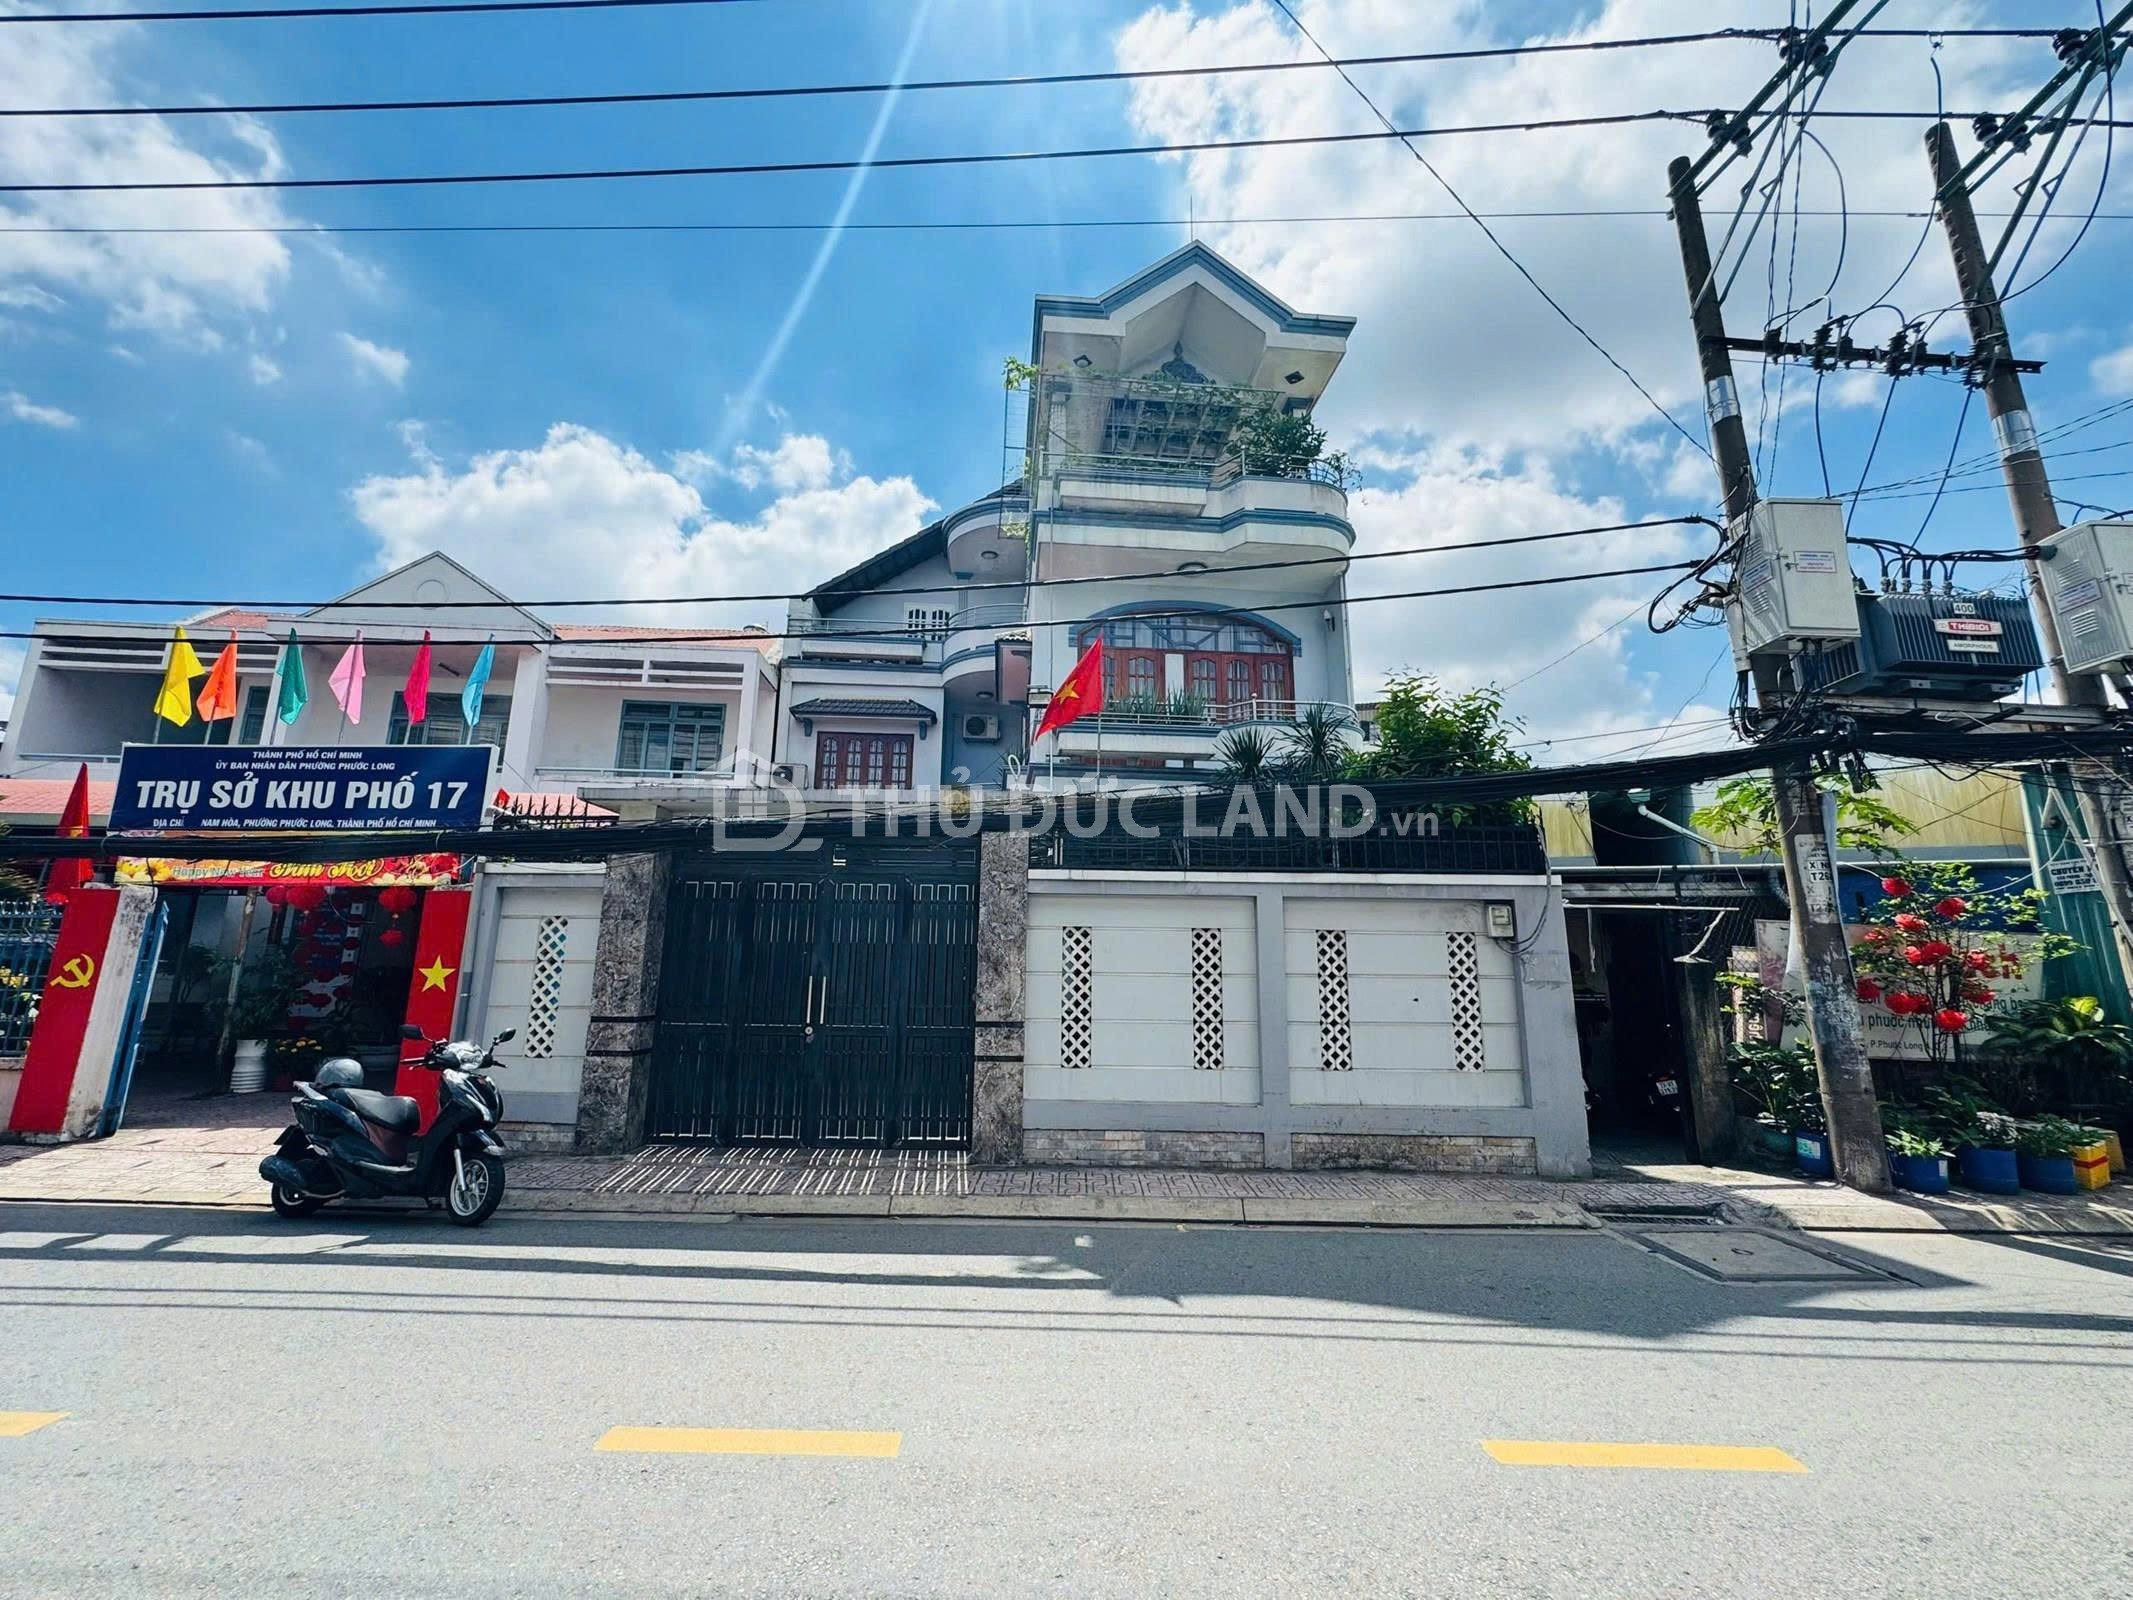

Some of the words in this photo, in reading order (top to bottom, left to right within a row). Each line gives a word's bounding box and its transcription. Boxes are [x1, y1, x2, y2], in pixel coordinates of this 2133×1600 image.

[1955, 604, 1974, 613] 400
[252, 750, 283, 759] THÀNH
[285, 749, 304, 759] PHỐ
[321, 750, 338, 759] CHÍ
[230, 762, 249, 770] BAN
[251, 761, 276, 770] NHÂN
[278, 761, 297, 770] DÂN
[299, 761, 336, 771] PHƯỜNG
[338, 761, 369, 771] PHƯỚC
[371, 762, 396, 771] LONG
[136, 780, 201, 815] TRỤ
[208, 771, 260, 809] SỞ
[265, 781, 337, 809] KHU
[344, 771, 419, 809] PHỐ
[427, 781, 469, 809] 17
[200, 819, 220, 828] NAM
[415, 819, 437, 828] MINH
[172, 866, 208, 880] Happy
